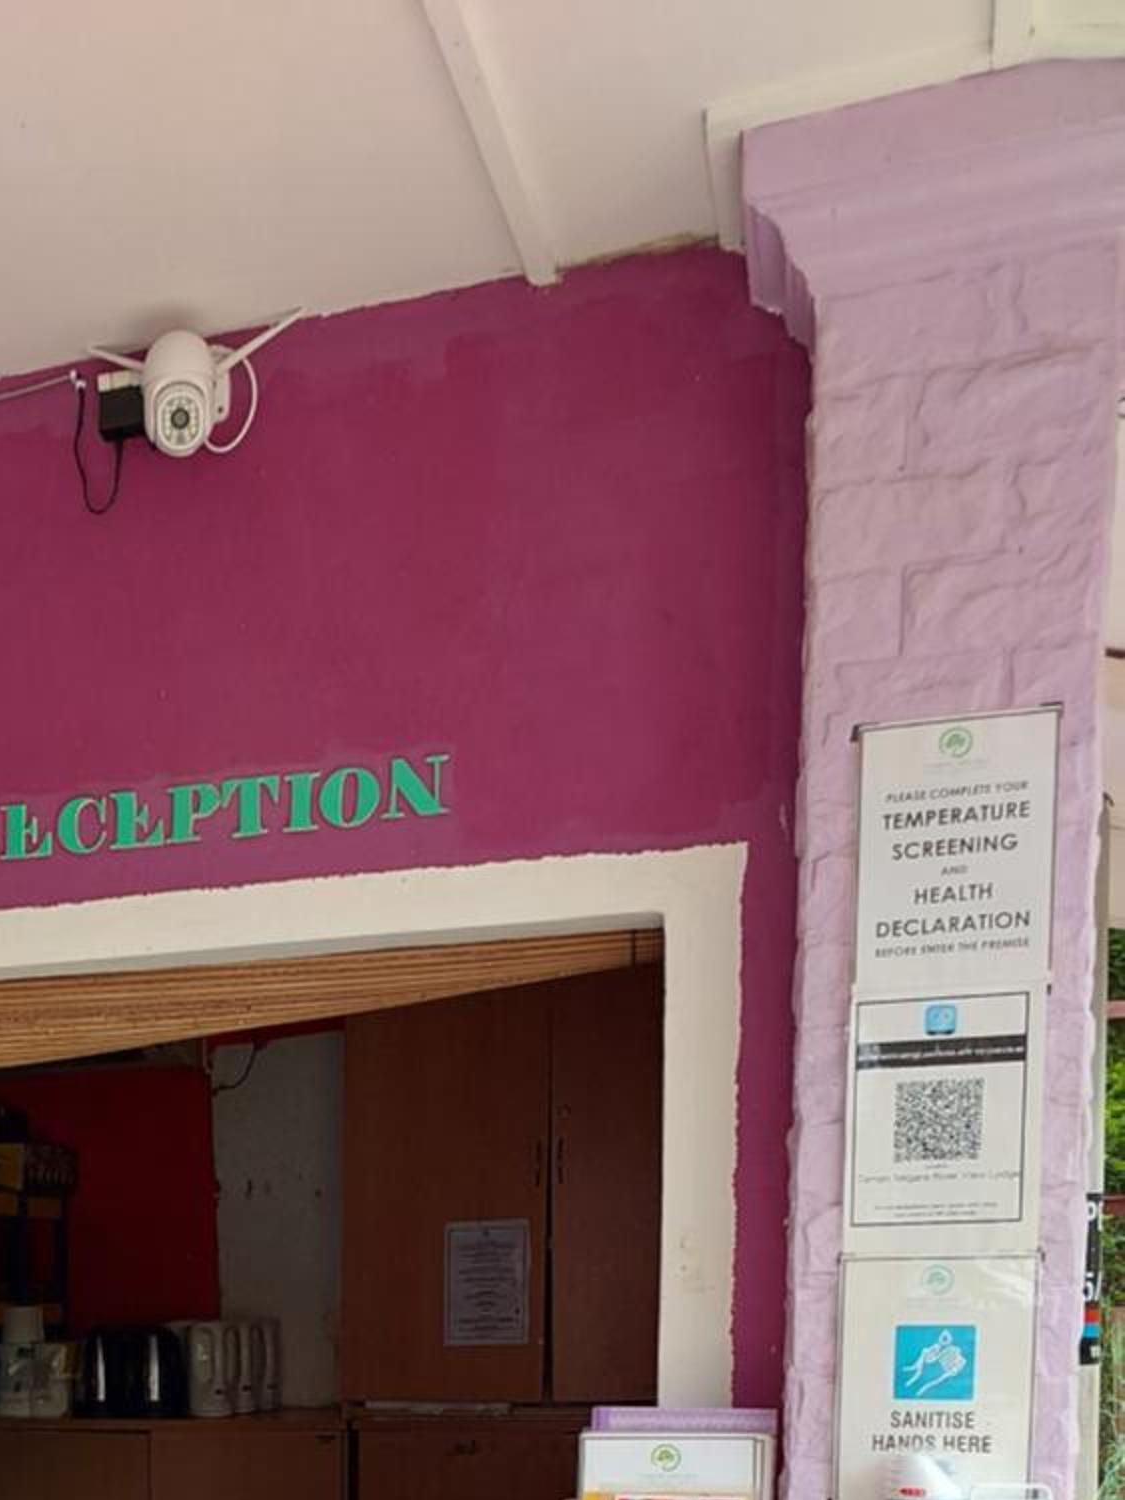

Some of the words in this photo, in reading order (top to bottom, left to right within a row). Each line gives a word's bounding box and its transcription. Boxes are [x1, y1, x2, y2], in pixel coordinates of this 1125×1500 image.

[886, 790, 926, 803] PLEASE
[930, 784, 992, 799] COMPLETE
[995, 780, 1029, 793] YOUR
[883, 800, 1031, 830] TEMPERATURE
[891, 833, 1018, 861] SCREENING
[941, 865, 968, 876] AND
[913, 882, 993, 905] HEALTH
[875, 911, 1031, 938] DECLARATION
[875, 945, 917, 958] BEFORE
[921, 943, 955, 955] ENTER
[958, 941, 977, 952] THE
[890, 1411, 976, 1430] SANITISE
[872, 1434, 937, 1453] HANDS
[943, 1435, 992, 1454] HERE
